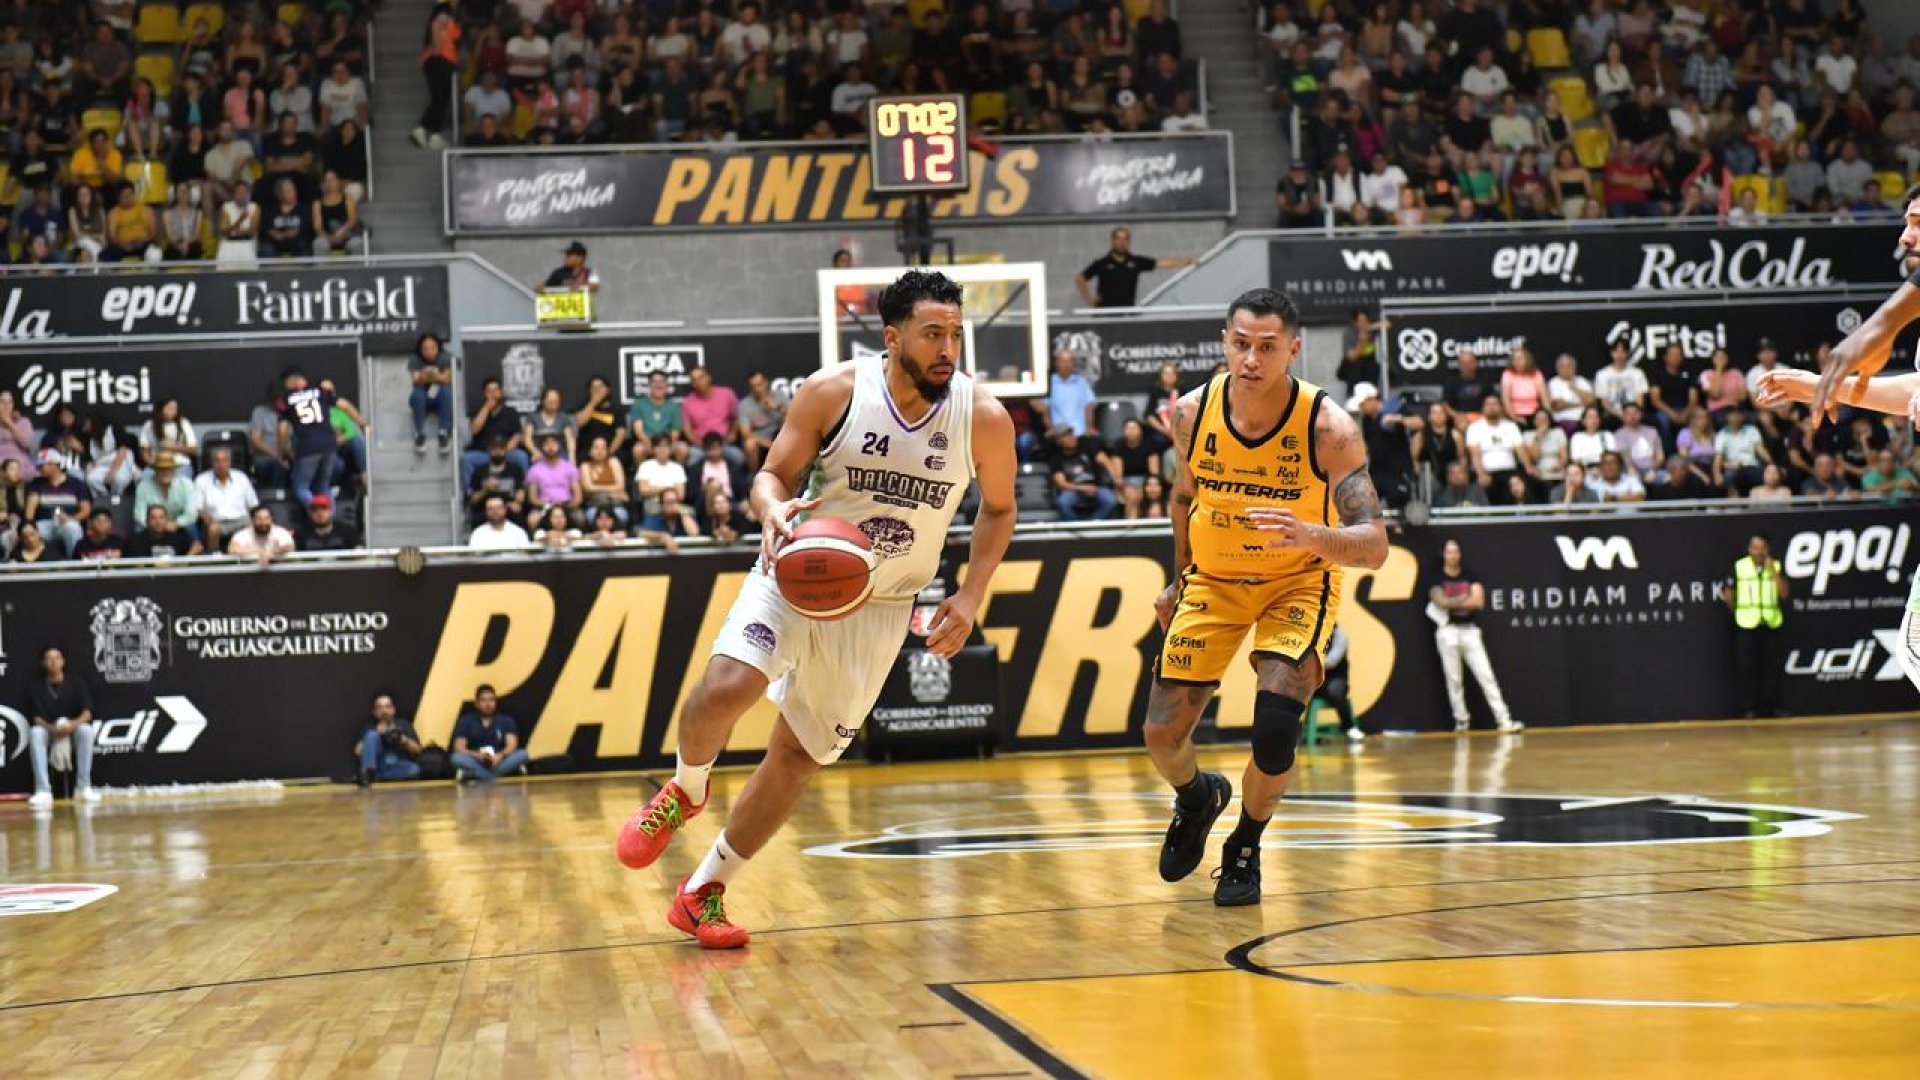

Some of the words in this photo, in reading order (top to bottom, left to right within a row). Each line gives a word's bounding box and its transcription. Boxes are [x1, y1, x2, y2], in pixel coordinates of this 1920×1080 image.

[902, 135, 955, 182] 12
[549, 182, 616, 213] NUNCA
[1492, 241, 1578, 290] epa!
[235, 275, 418, 325] Fairfield
[1284, 279, 1387, 295] MERIDIAM
[1397, 276, 1447, 291] PARK
[101, 281, 197, 331] epa!
[632, 353, 685, 374] IDEA
[61, 367, 151, 405] Fitsi
[295, 398, 324, 424] 51
[861, 431, 890, 457] 24
[1204, 431, 1217, 456] 4
[848, 466, 954, 509] HALCONES
[1195, 476, 1303, 500] PANTERAS
[1785, 522, 1911, 595] epa!
[1491, 584, 1627, 611] ERIDIAM
[1648, 581, 1725, 604] PARK
[174, 616, 289, 637] GOBIERNO
[308, 612, 389, 632] ESTADO
[1510, 609, 1685, 628] AGUASCALIENTES
[200, 633, 376, 658] AGUASCALIENTES
[1785, 638, 1877, 675] udi
